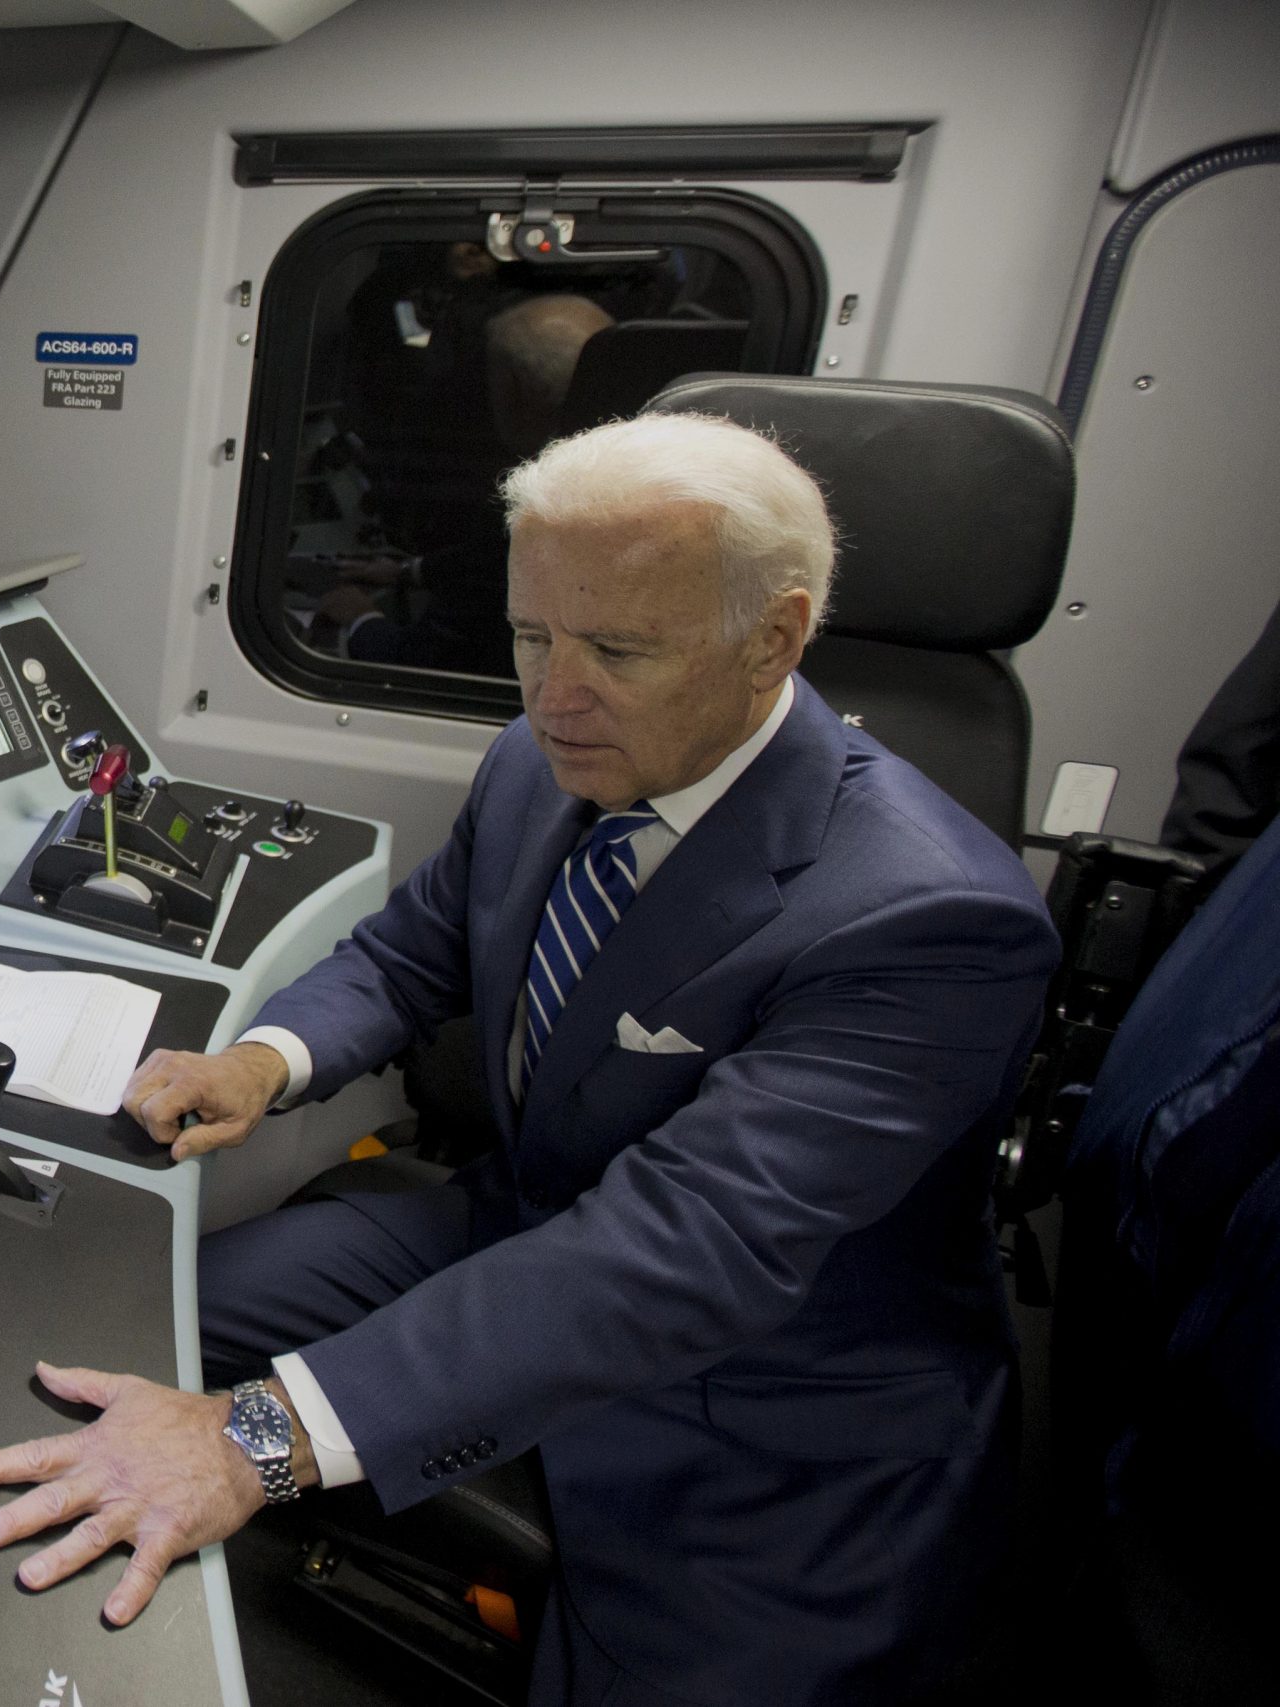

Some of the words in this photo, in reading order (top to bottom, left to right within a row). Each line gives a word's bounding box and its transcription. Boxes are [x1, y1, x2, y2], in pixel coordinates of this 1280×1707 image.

[42, 340, 133, 356] ACS64-600-R
[47, 369, 72, 381] Fully
[73, 371, 121, 382] Equipped
[51, 383, 72, 393] FRA
[74, 384, 95, 393] Part
[97, 384, 116, 395] 223
[63, 396, 102, 409] Glazing
[41, 1164, 52, 1172] B
